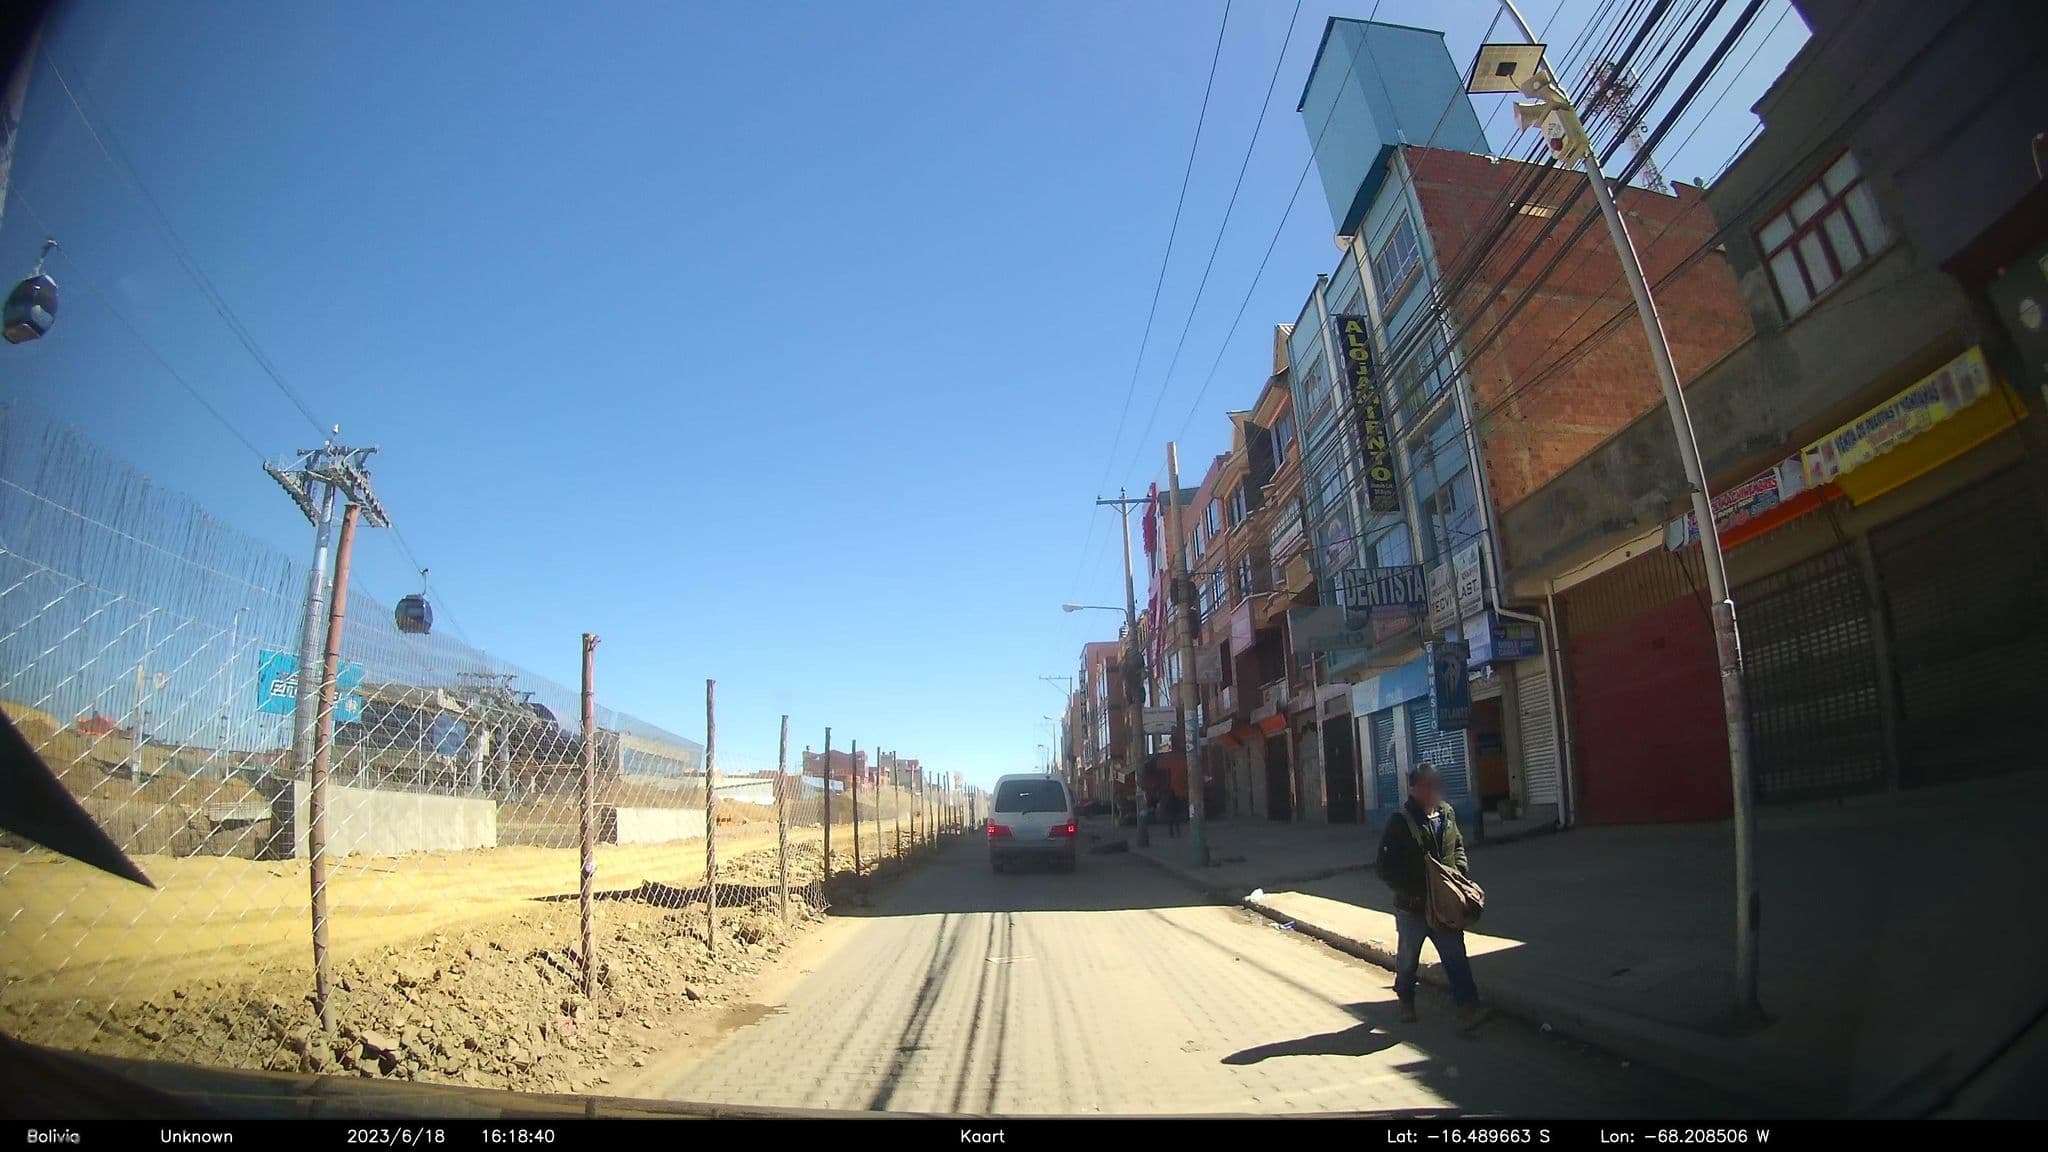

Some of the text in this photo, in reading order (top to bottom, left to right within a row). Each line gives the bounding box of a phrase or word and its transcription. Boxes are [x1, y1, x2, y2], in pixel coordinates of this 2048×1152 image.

[1345, 320, 1392, 481] ALOJAMIENTO
[1344, 566, 1427, 607] DENTISTA
[1425, 643, 1438, 730] GIMNASIO
